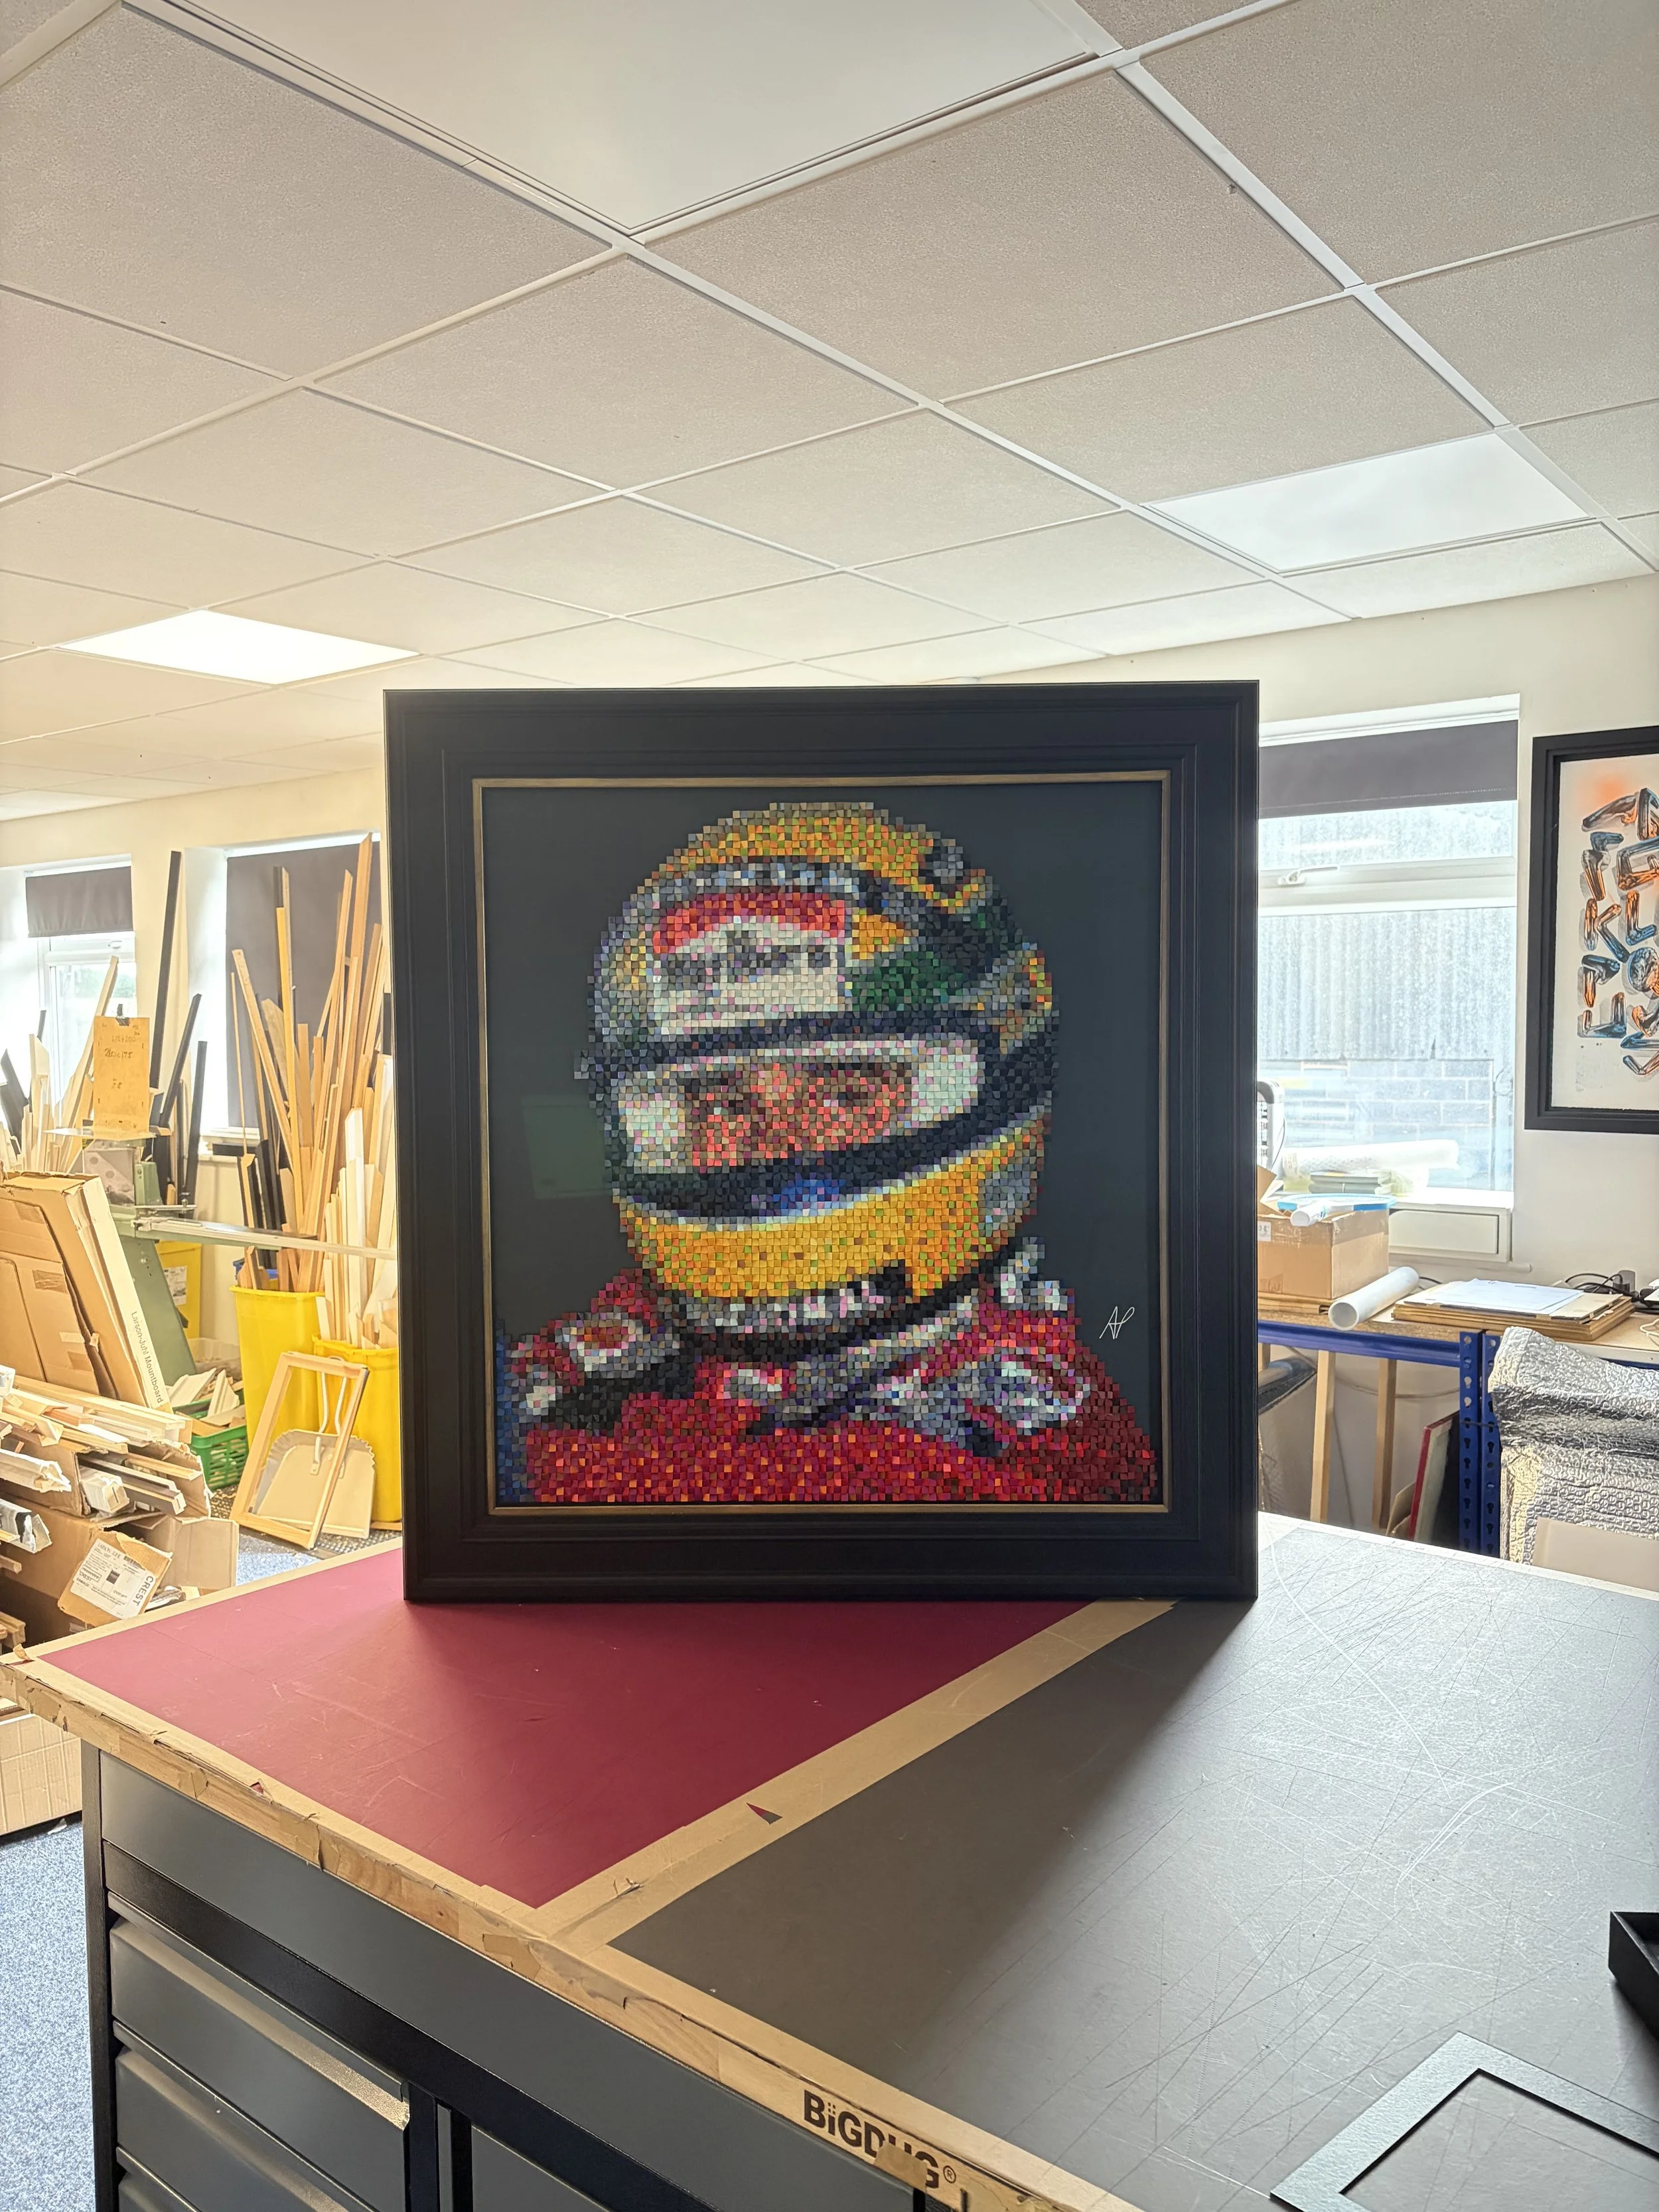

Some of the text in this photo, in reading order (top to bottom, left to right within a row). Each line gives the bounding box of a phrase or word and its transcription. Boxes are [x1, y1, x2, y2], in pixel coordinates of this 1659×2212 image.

[131, 1311, 164, 1404] Larson-Juhl Mountboard
[132, 1576, 154, 1607] CREST
